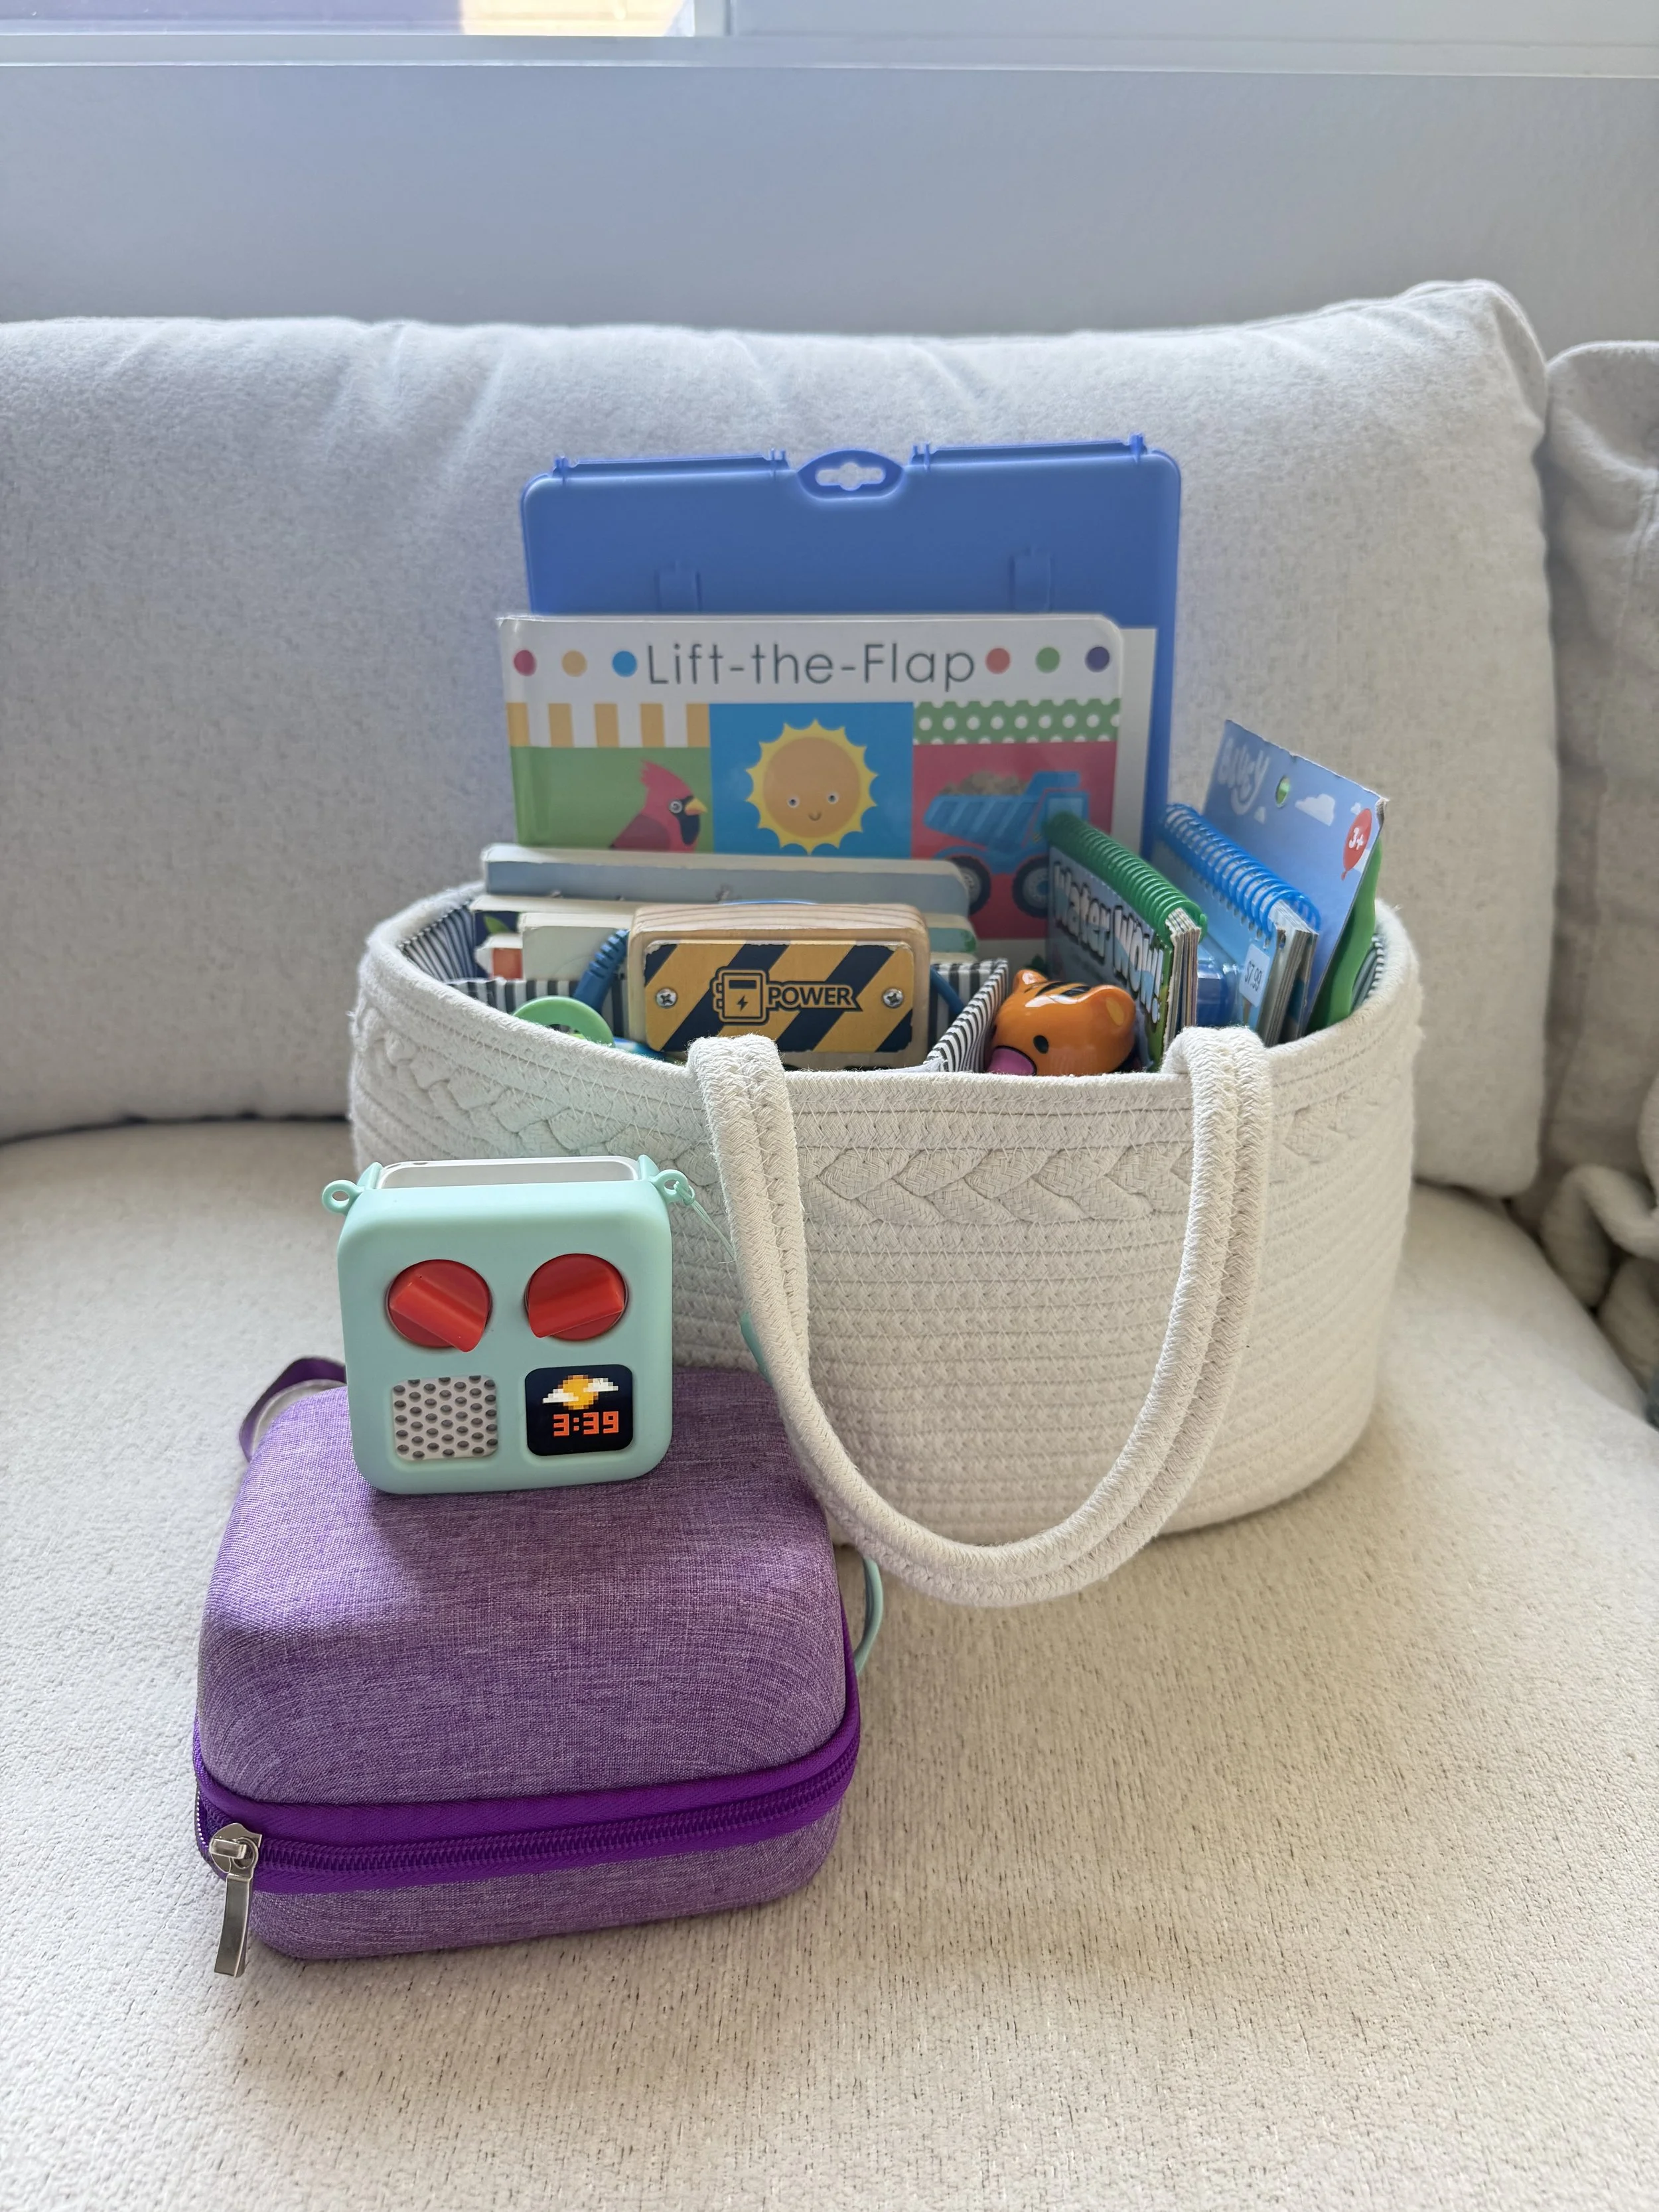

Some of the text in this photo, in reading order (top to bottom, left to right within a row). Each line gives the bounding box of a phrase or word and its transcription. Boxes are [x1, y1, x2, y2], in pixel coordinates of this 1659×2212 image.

[647, 642, 975, 692] Lift-the-Flap
[1348, 827, 1364, 851] 3+
[1052, 861, 1112, 960] Water
[1244, 960, 1262, 992] $7.99
[768, 986, 852, 1006] POWER
[552, 1411, 619, 1438] 3:39
